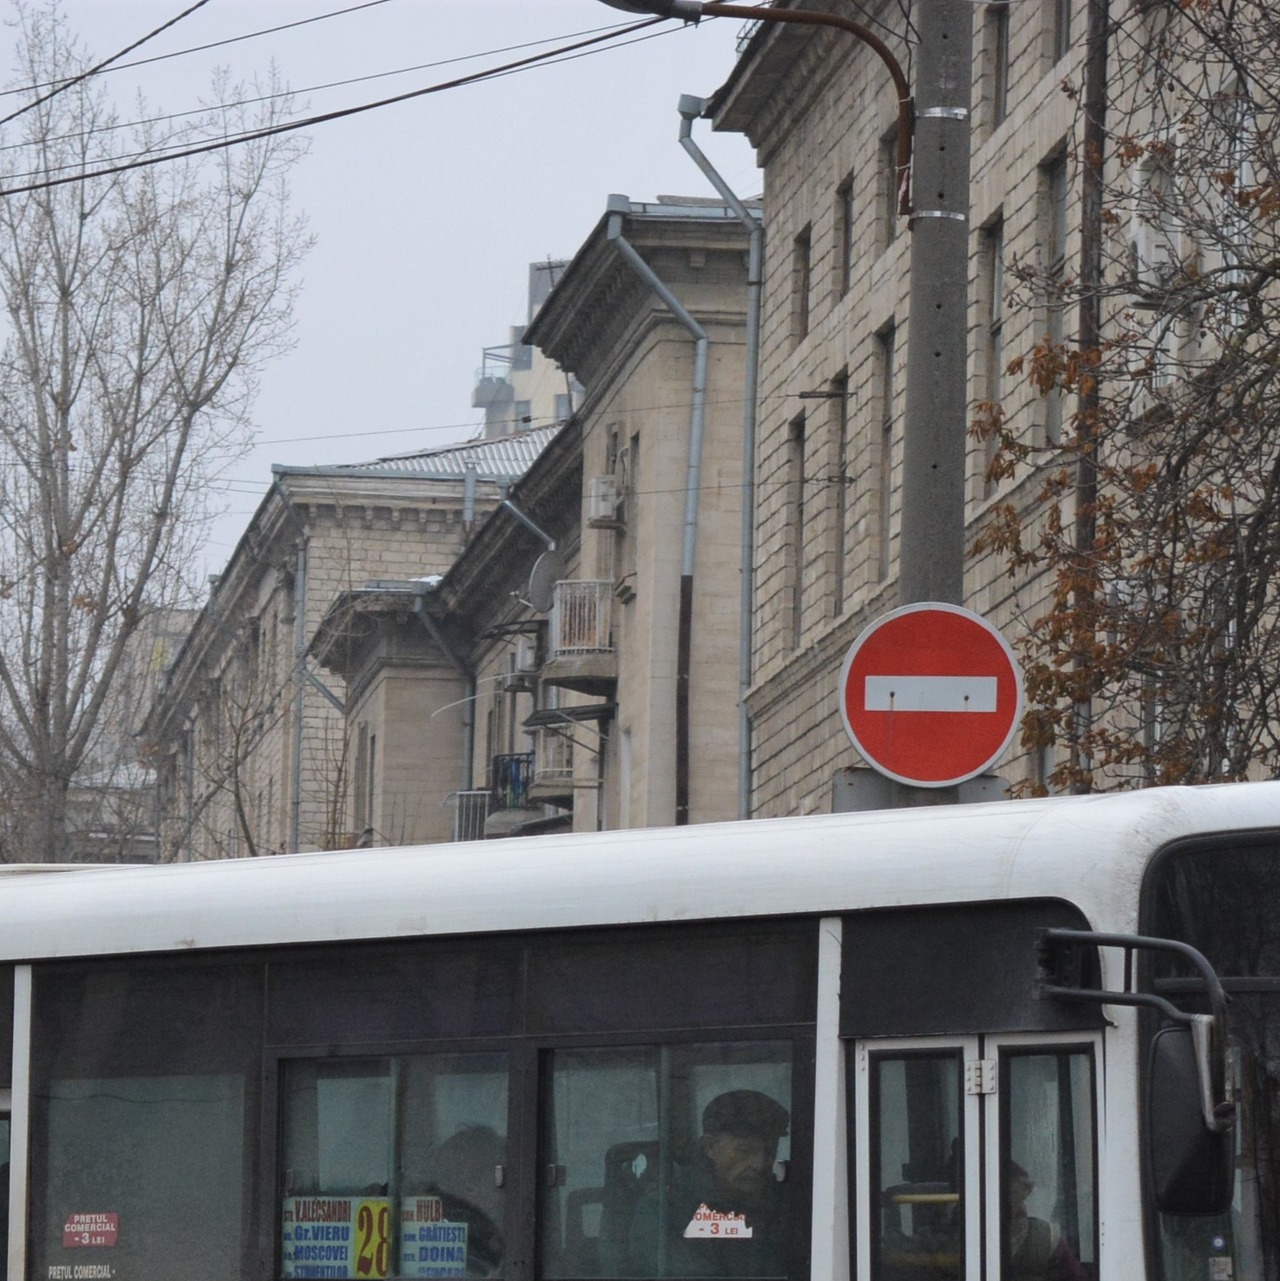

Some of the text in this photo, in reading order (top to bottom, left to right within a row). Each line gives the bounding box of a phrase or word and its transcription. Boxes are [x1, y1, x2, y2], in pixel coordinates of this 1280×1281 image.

[64, 1223, 116, 1232] COMERCIAL
[294, 1225, 350, 1241] Gr.VIERU
[710, 1222, 719, 1235] 3
[82, 1232, 90, 1244] 3
[294, 1245, 349, 1261] MOSCOVEI
[419, 1246, 464, 1262] DOINA
[73, 1265, 111, 1279] COMERCIAL
